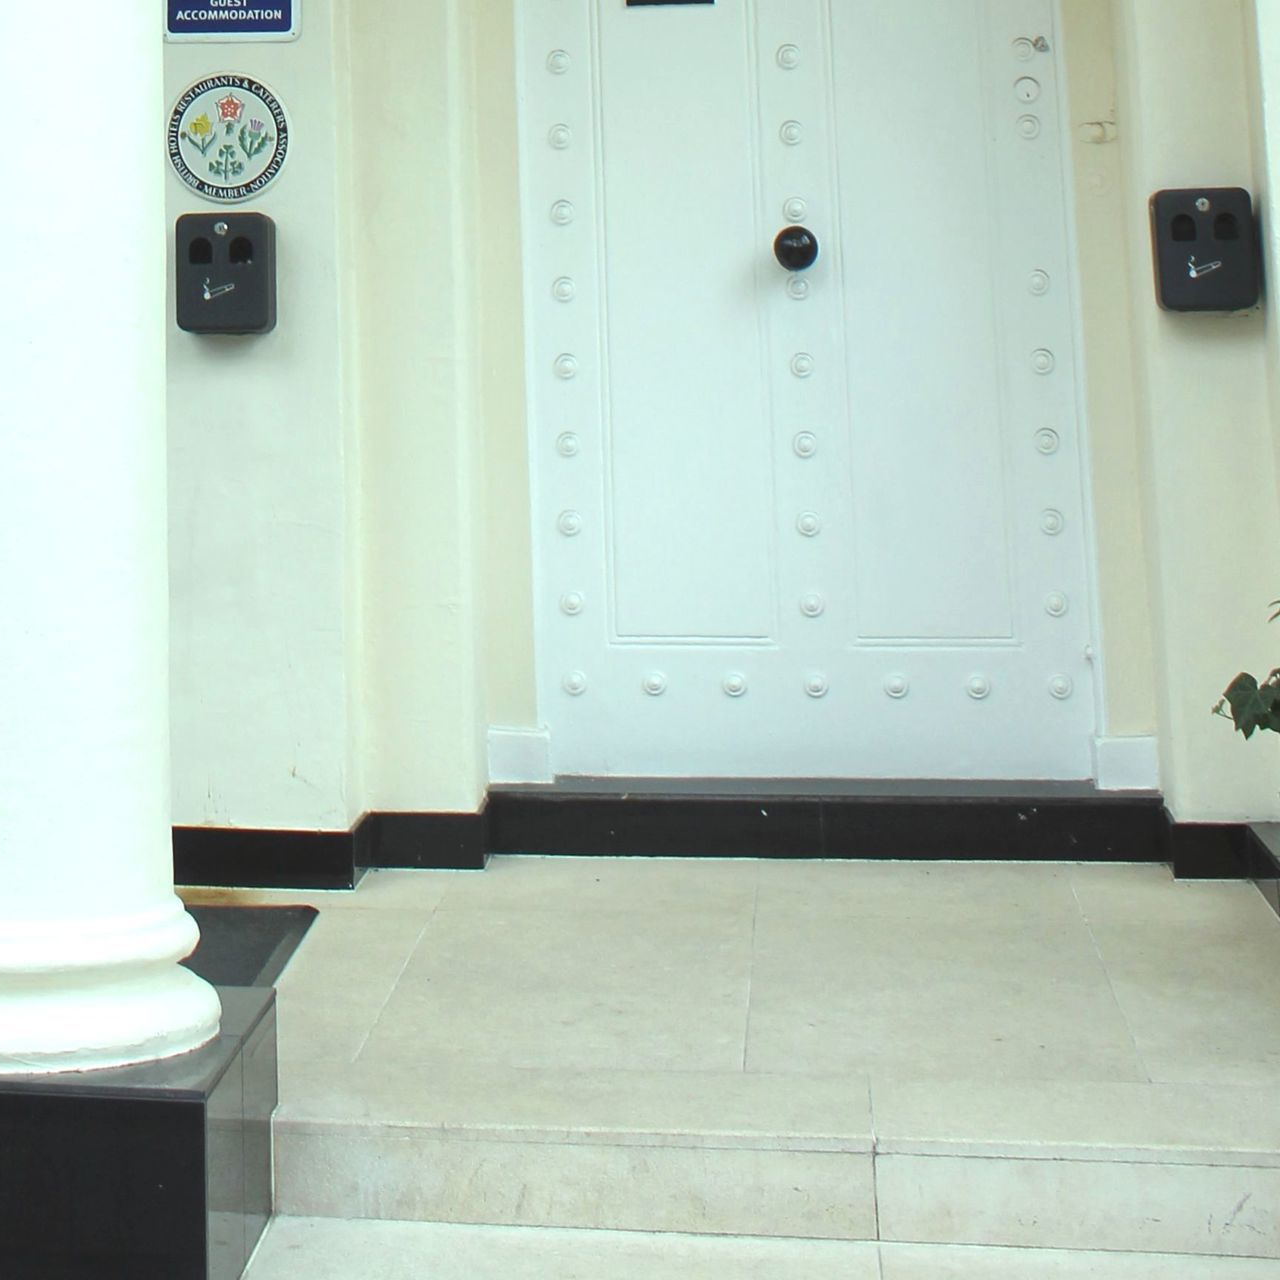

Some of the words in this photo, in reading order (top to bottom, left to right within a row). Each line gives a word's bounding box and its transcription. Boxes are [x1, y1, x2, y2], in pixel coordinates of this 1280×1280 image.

[176, 9, 282, 21] ACCOMMODATION
[176, 76, 241, 114] RESTAURANTS
[251, 83, 286, 130] CATERERS
[169, 114, 181, 154] HOTELS
[172, 155, 199, 190] BRITISH
[249, 132, 289, 192] ASSOCIATION
[203, 185, 247, 199] MEMBER
